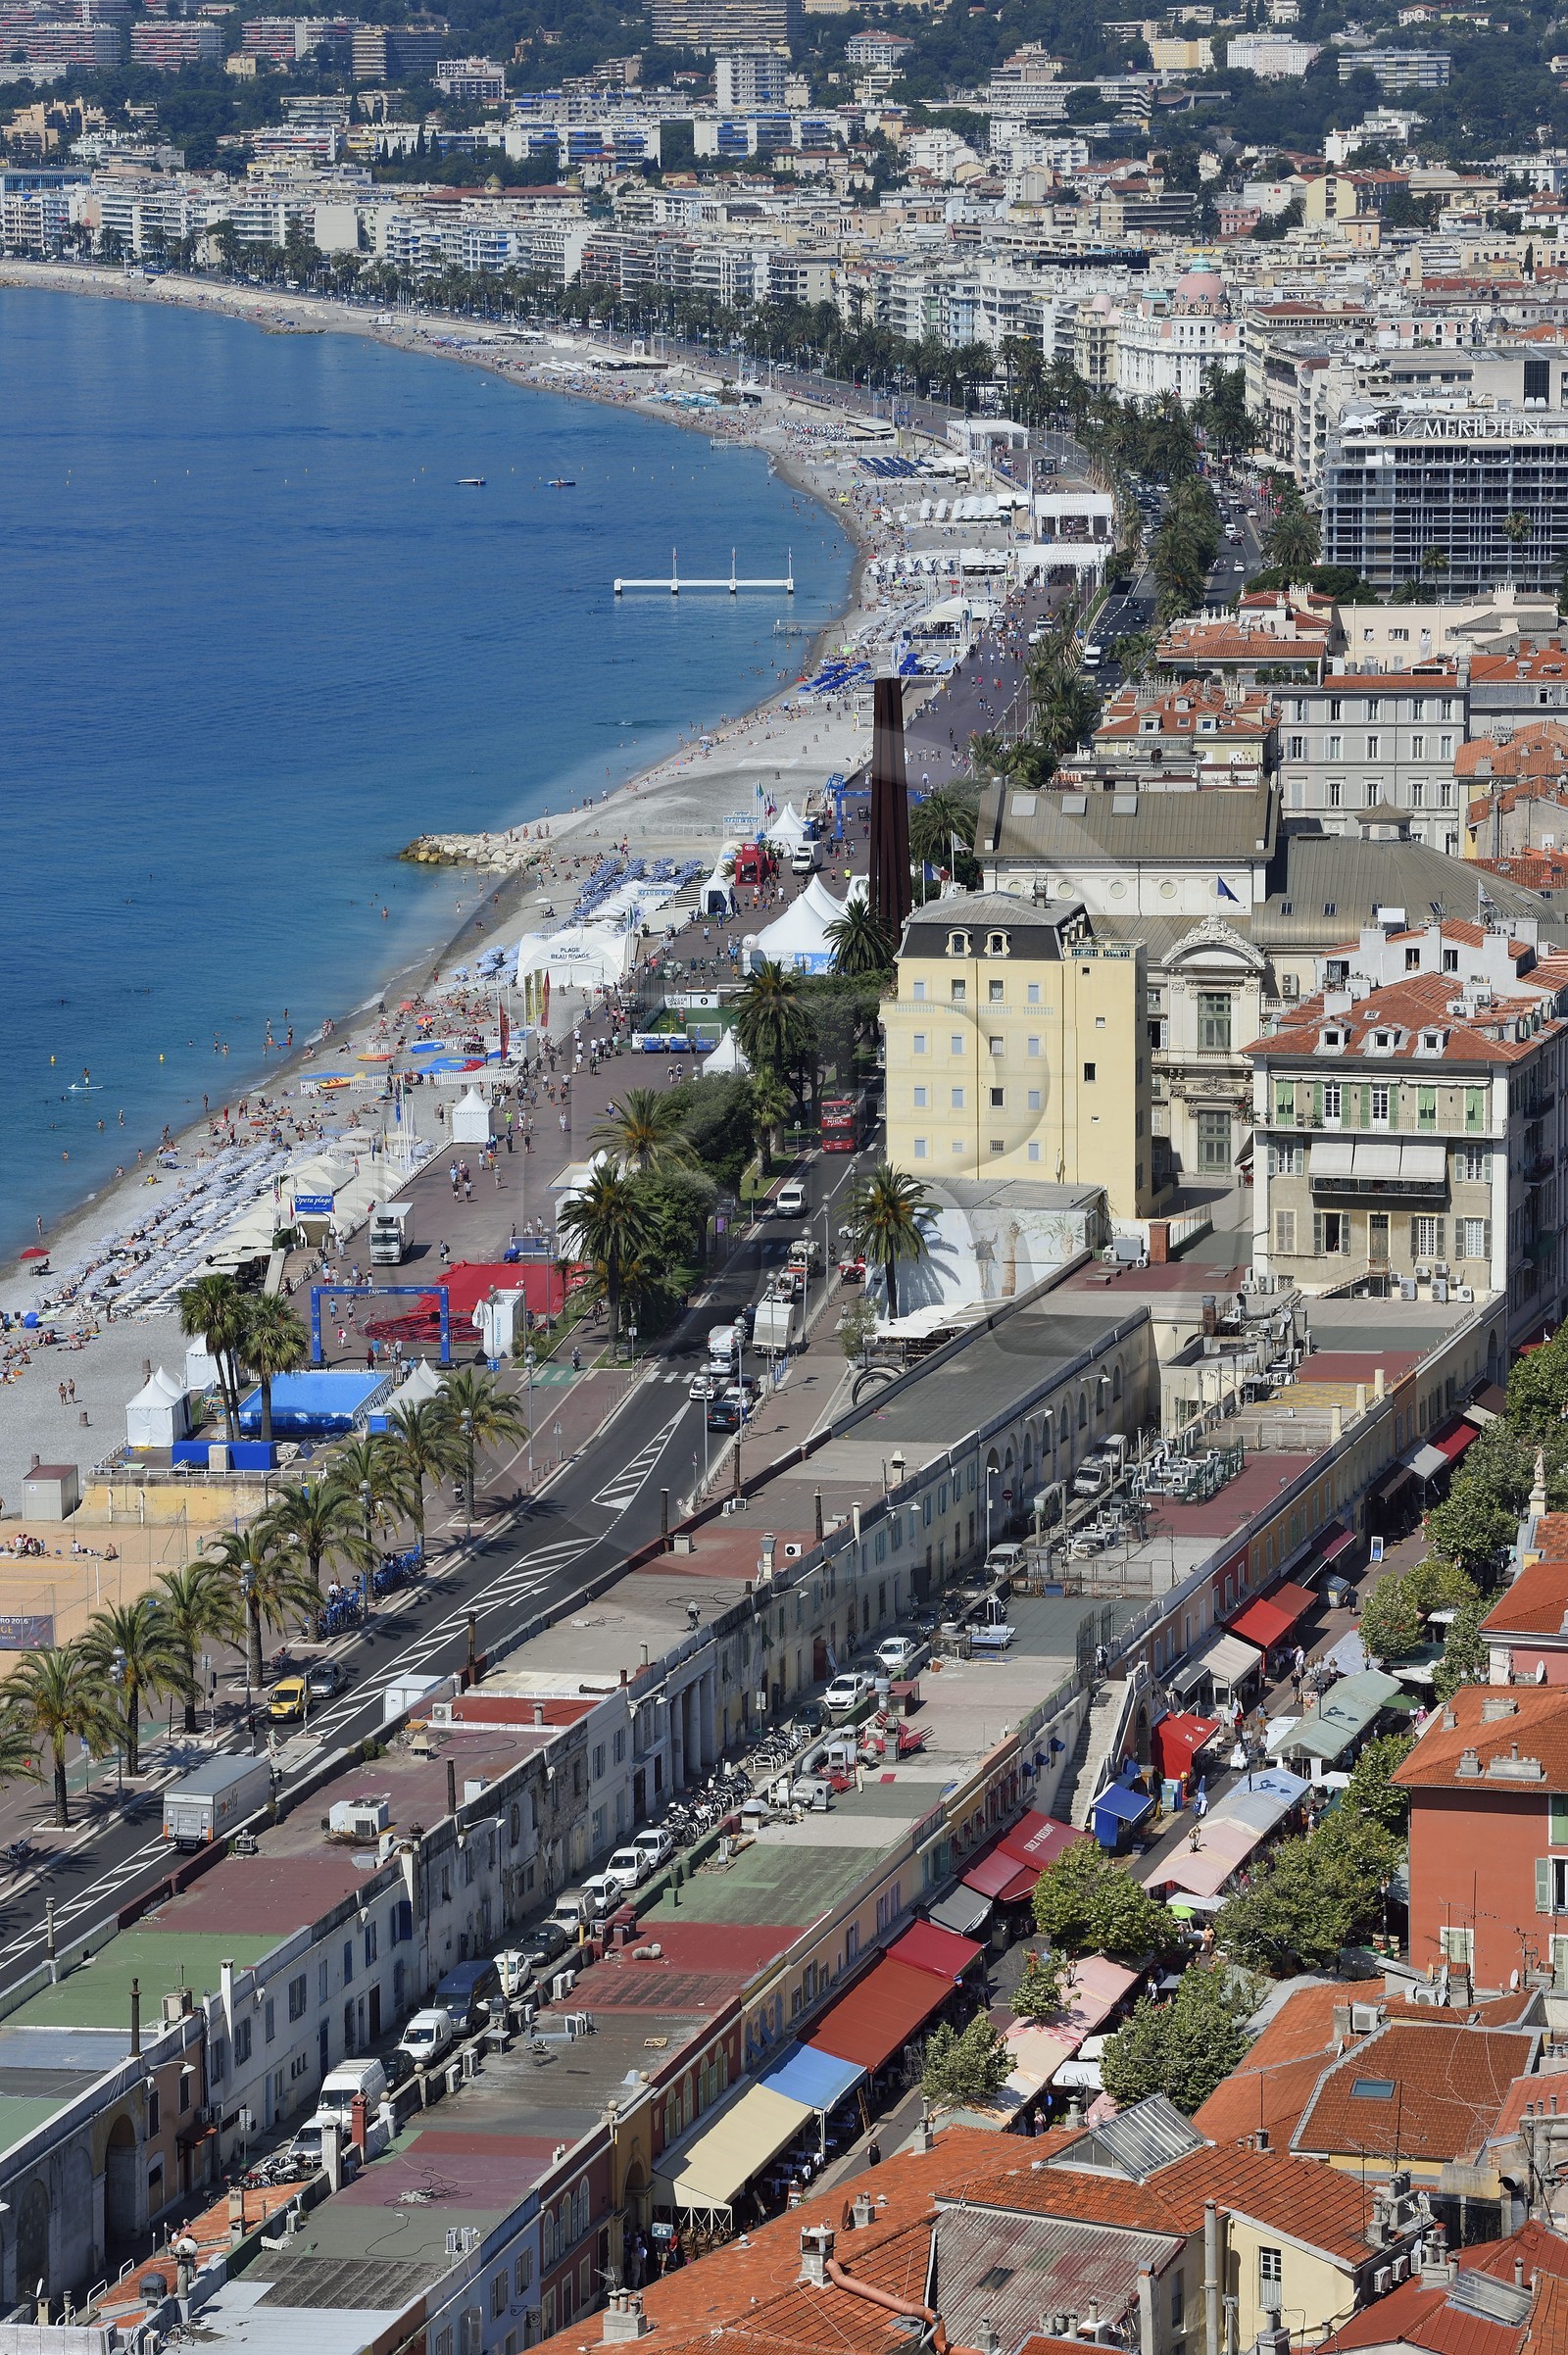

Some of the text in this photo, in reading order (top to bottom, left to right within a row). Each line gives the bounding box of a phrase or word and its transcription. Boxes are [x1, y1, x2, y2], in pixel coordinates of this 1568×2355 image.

[1396, 417, 1545, 439] Le MERIDIEN
[295, 1196, 332, 1205] Opera plage
